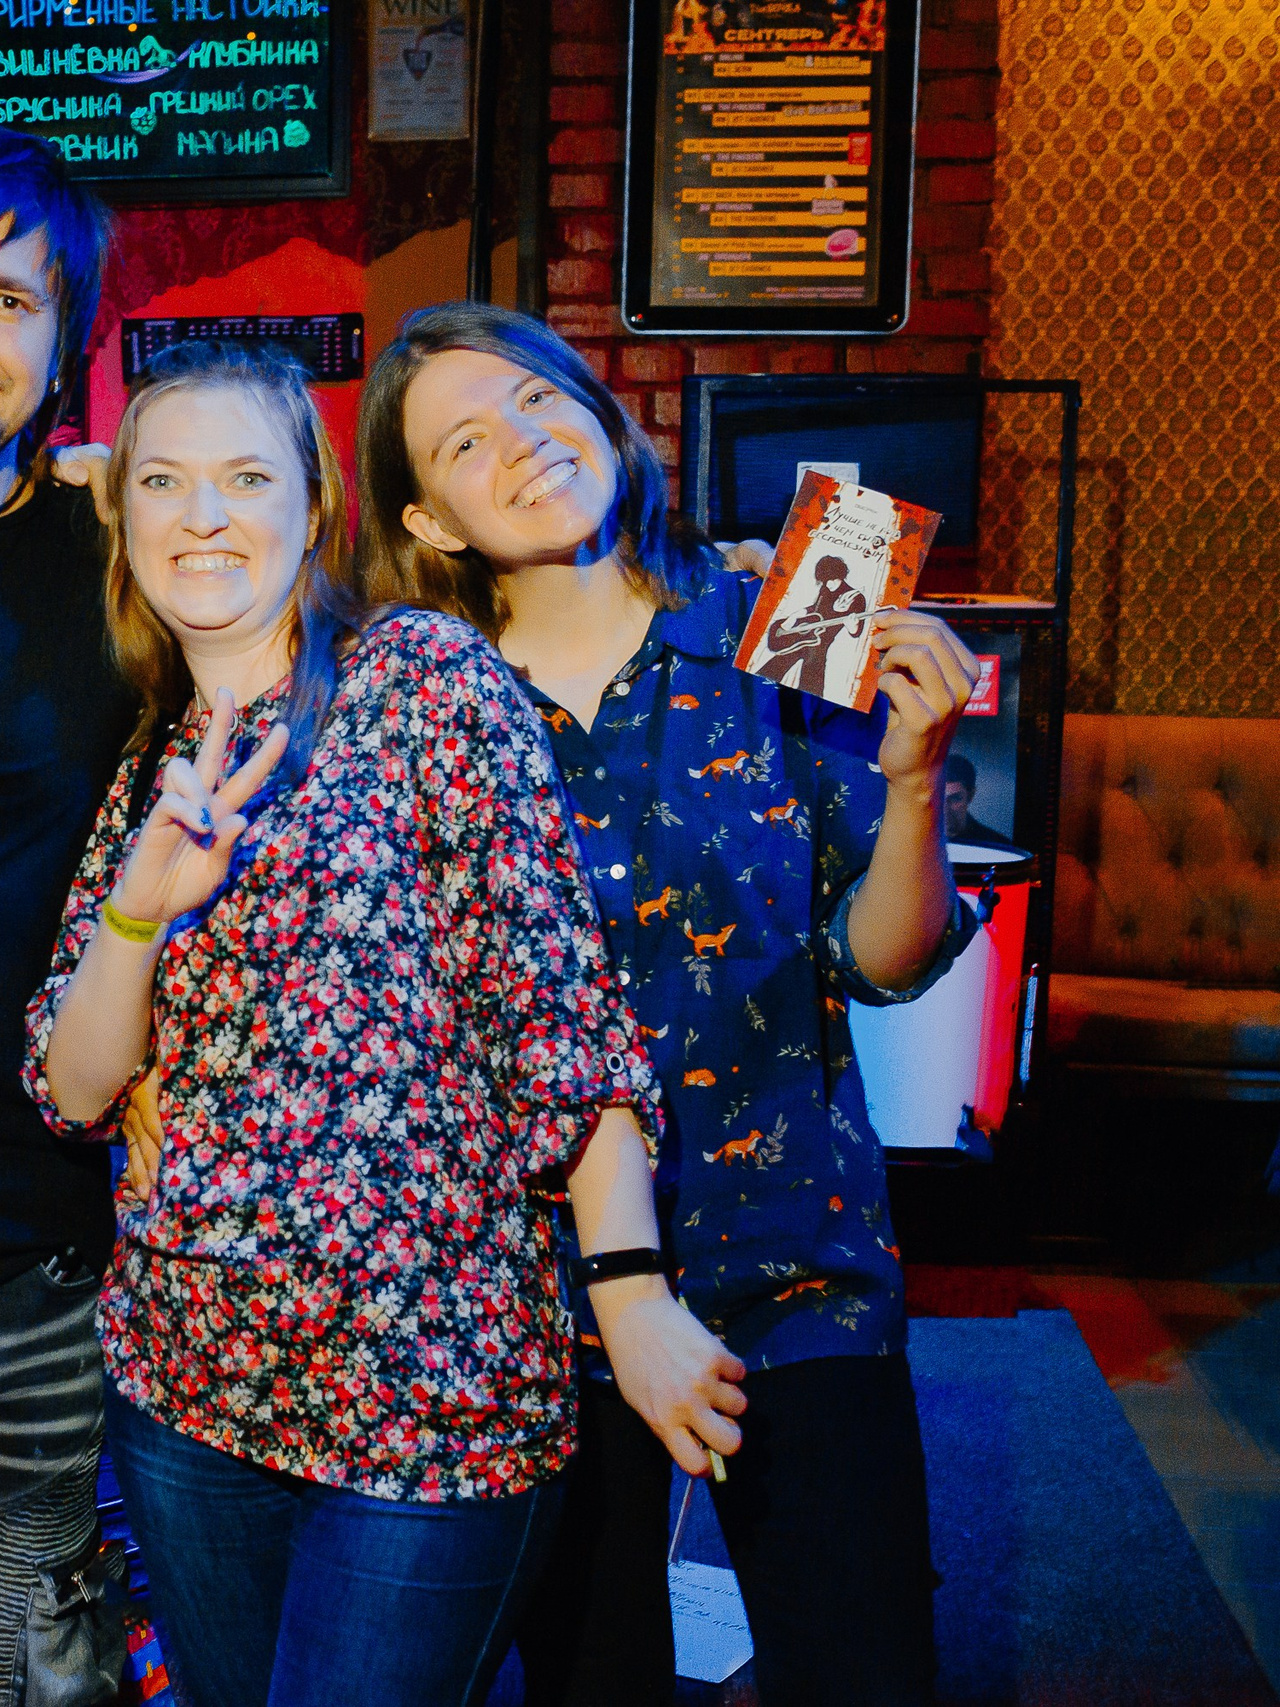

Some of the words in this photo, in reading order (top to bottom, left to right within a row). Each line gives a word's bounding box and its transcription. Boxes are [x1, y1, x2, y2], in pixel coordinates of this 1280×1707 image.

[724, 27, 825, 43] СЕНТЯБРЬ
[189, 39, 319, 69] КЛУБНИКА
[149, 81, 245, 115] ГРЕЦКИЙ
[252, 84, 319, 111] ОРЕХ
[48, 134, 139, 162] ОВНИК
